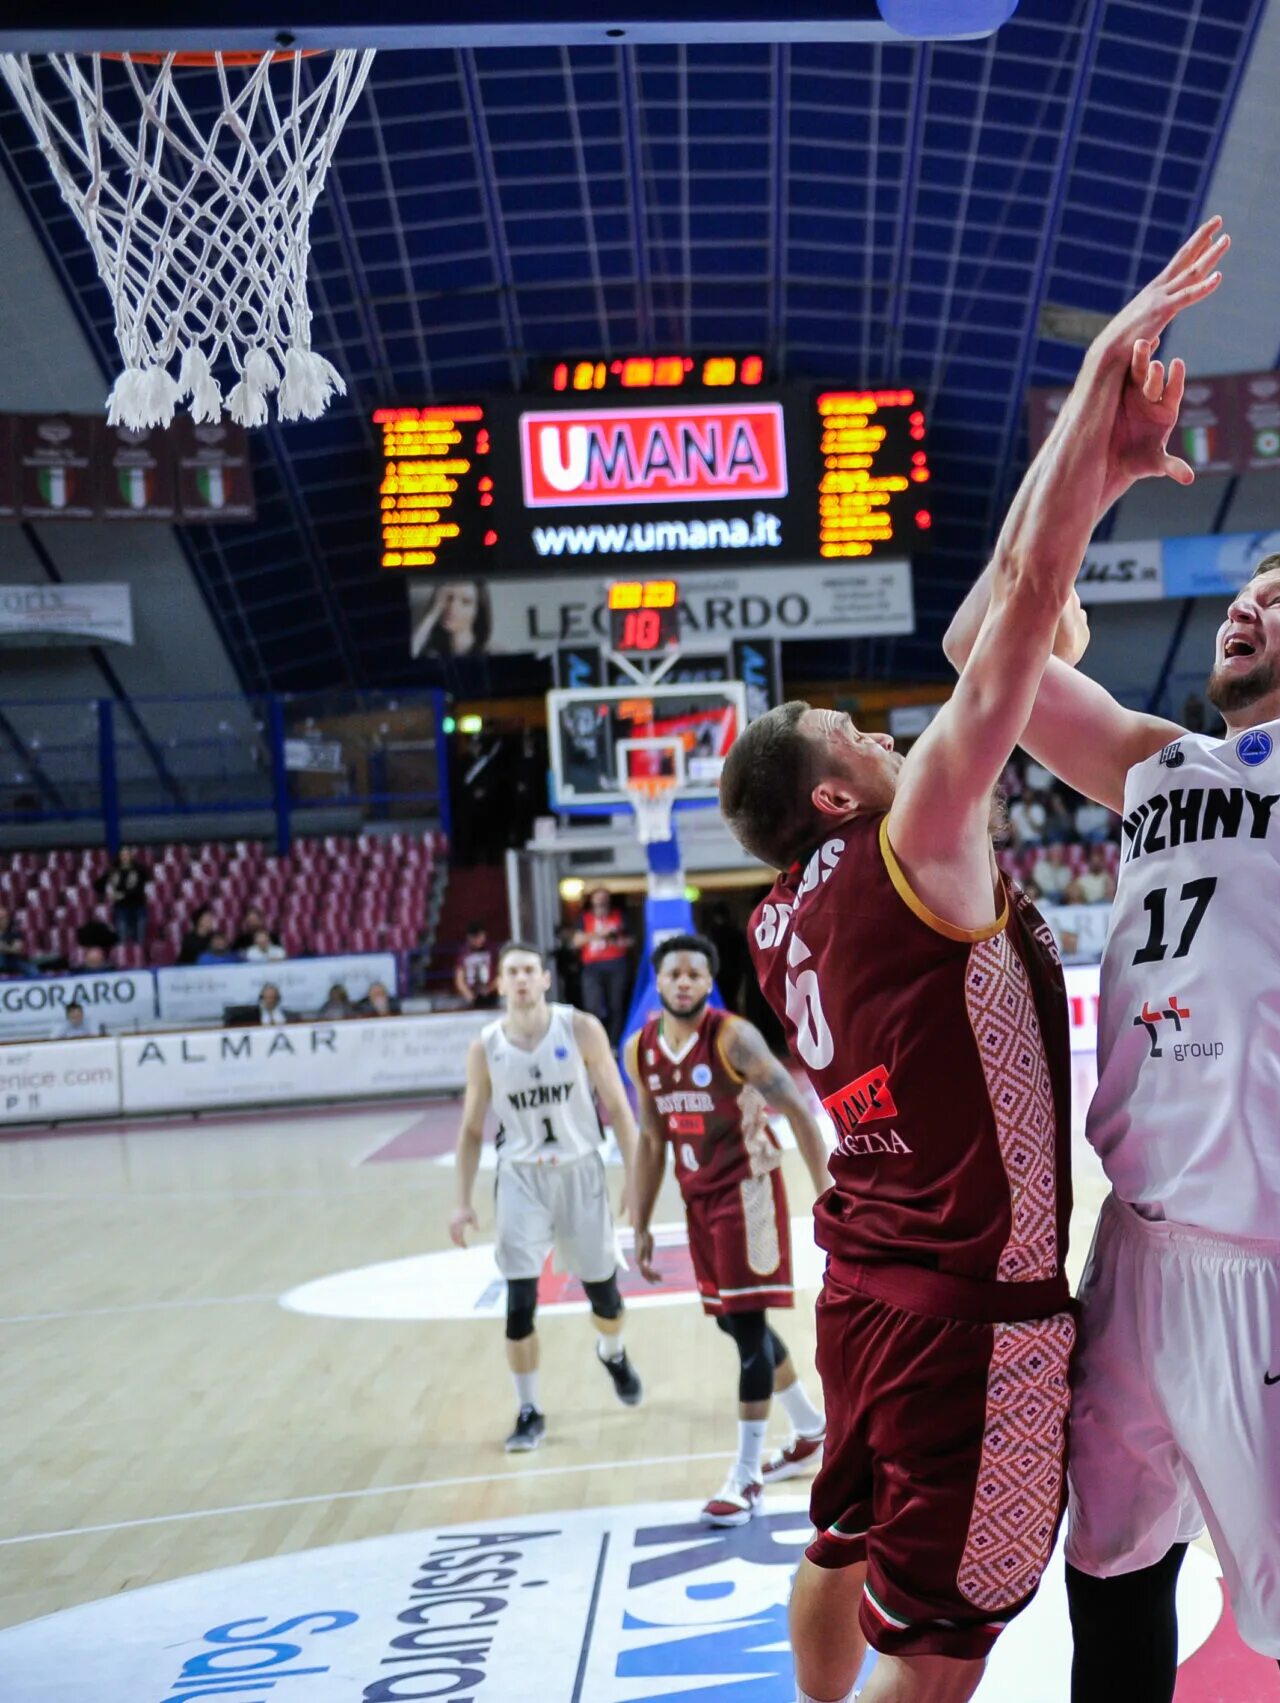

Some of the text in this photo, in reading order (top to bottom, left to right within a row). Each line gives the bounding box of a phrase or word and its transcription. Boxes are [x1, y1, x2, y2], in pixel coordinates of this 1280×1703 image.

[540, 419, 767, 491] UMANA
[531, 511, 782, 556] www.umana.it
[1132, 877, 1218, 966] 17
[0, 978, 136, 1013] GORARO
[137, 1028, 337, 1067] ALMAR
[1173, 1041, 1225, 1062] group
[507, 1082, 575, 1112] NIZHNY
[541, 1116, 559, 1143] 1
